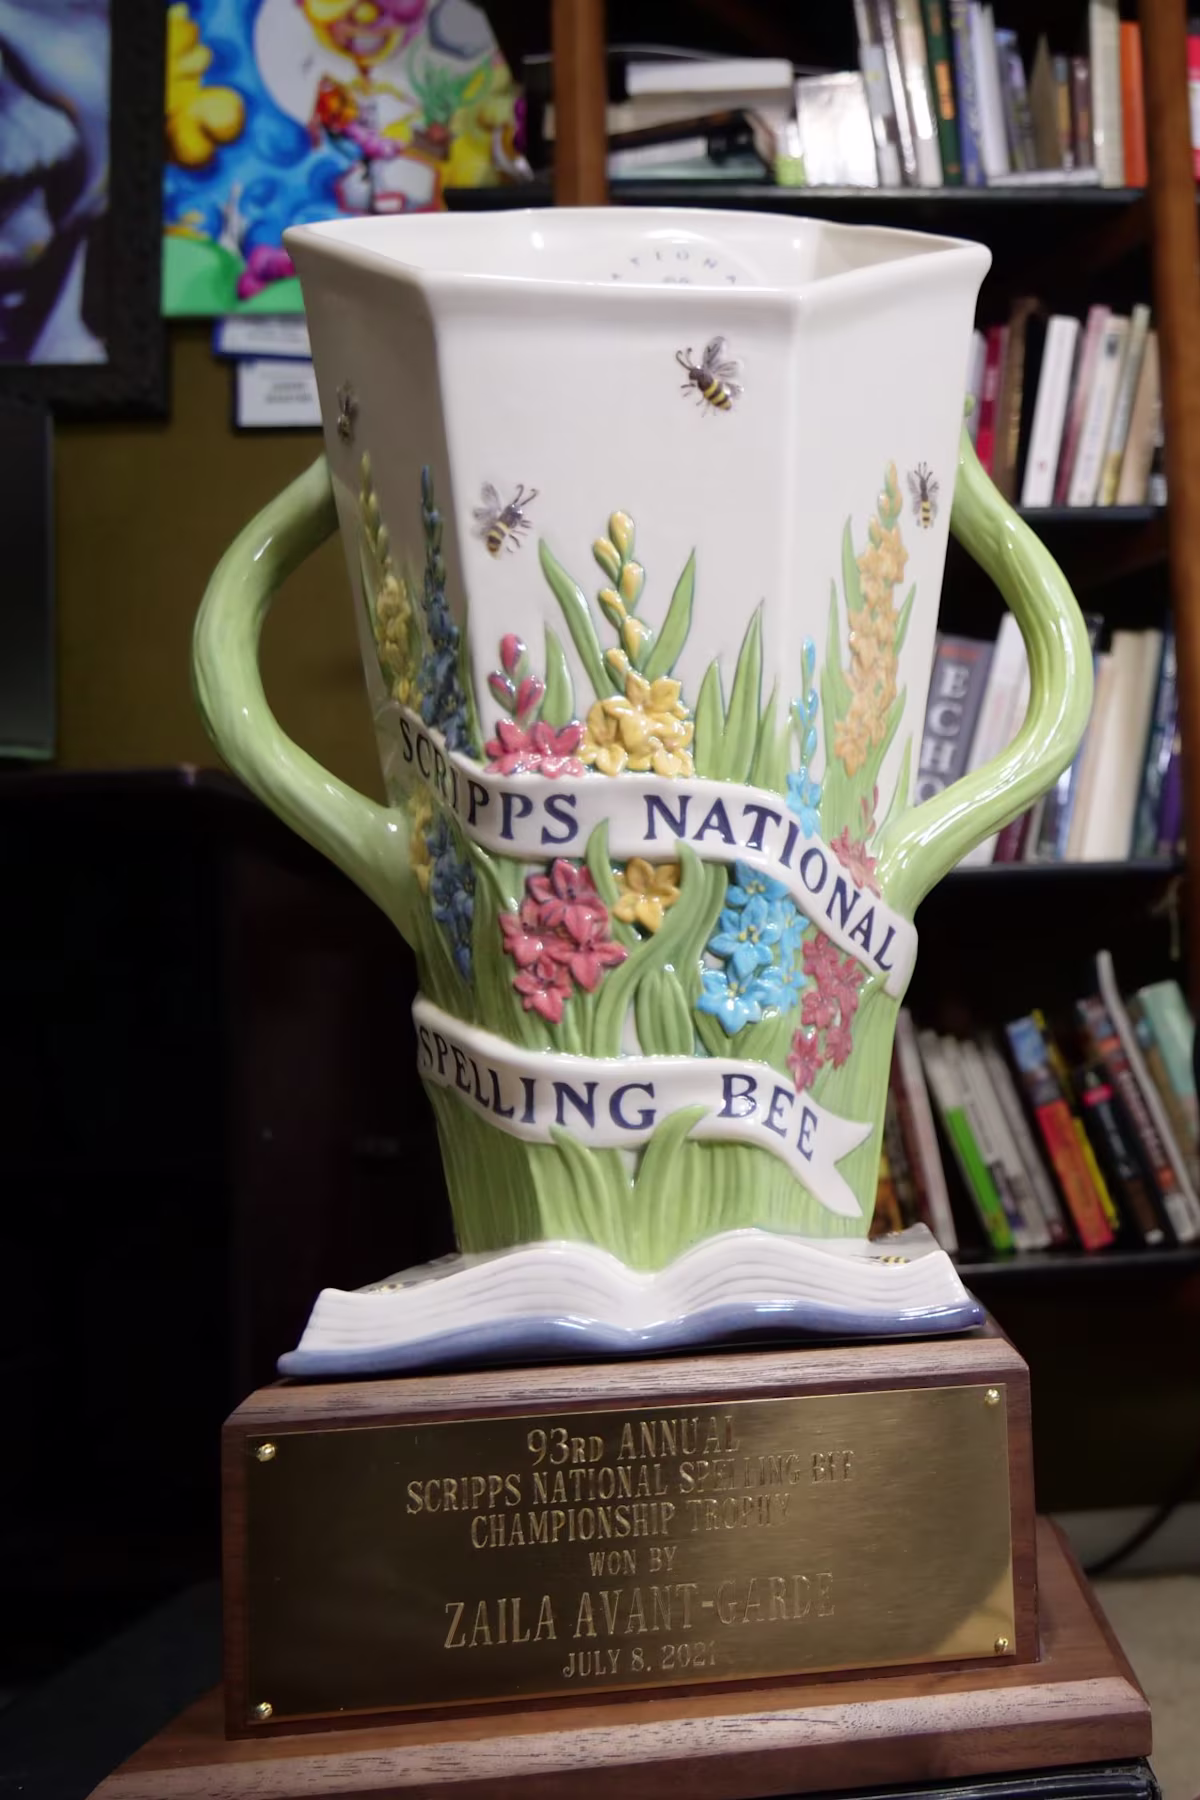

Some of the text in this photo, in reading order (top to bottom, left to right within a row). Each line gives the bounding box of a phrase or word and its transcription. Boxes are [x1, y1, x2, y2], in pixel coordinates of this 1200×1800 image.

[400, 717, 897, 972] SCRIPPS NATIONAL
[418, 1027, 819, 1161] SPELLING BEE
[527, 1414, 741, 1467] 93RD ANNUAL
[405, 1473, 522, 1515] SCRIPPS
[532, 1463, 669, 1505] NATIONAL
[679, 1454, 801, 1494] SPELLING
[471, 1492, 791, 1549] CHAMPIONSHIP TROPHY
[588, 1545, 678, 1577] WON BY
[444, 1571, 835, 1649] ZAILA AVANT-GARDE
[562, 1648, 621, 1678] JULY
[661, 1639, 716, 1670] 2021
